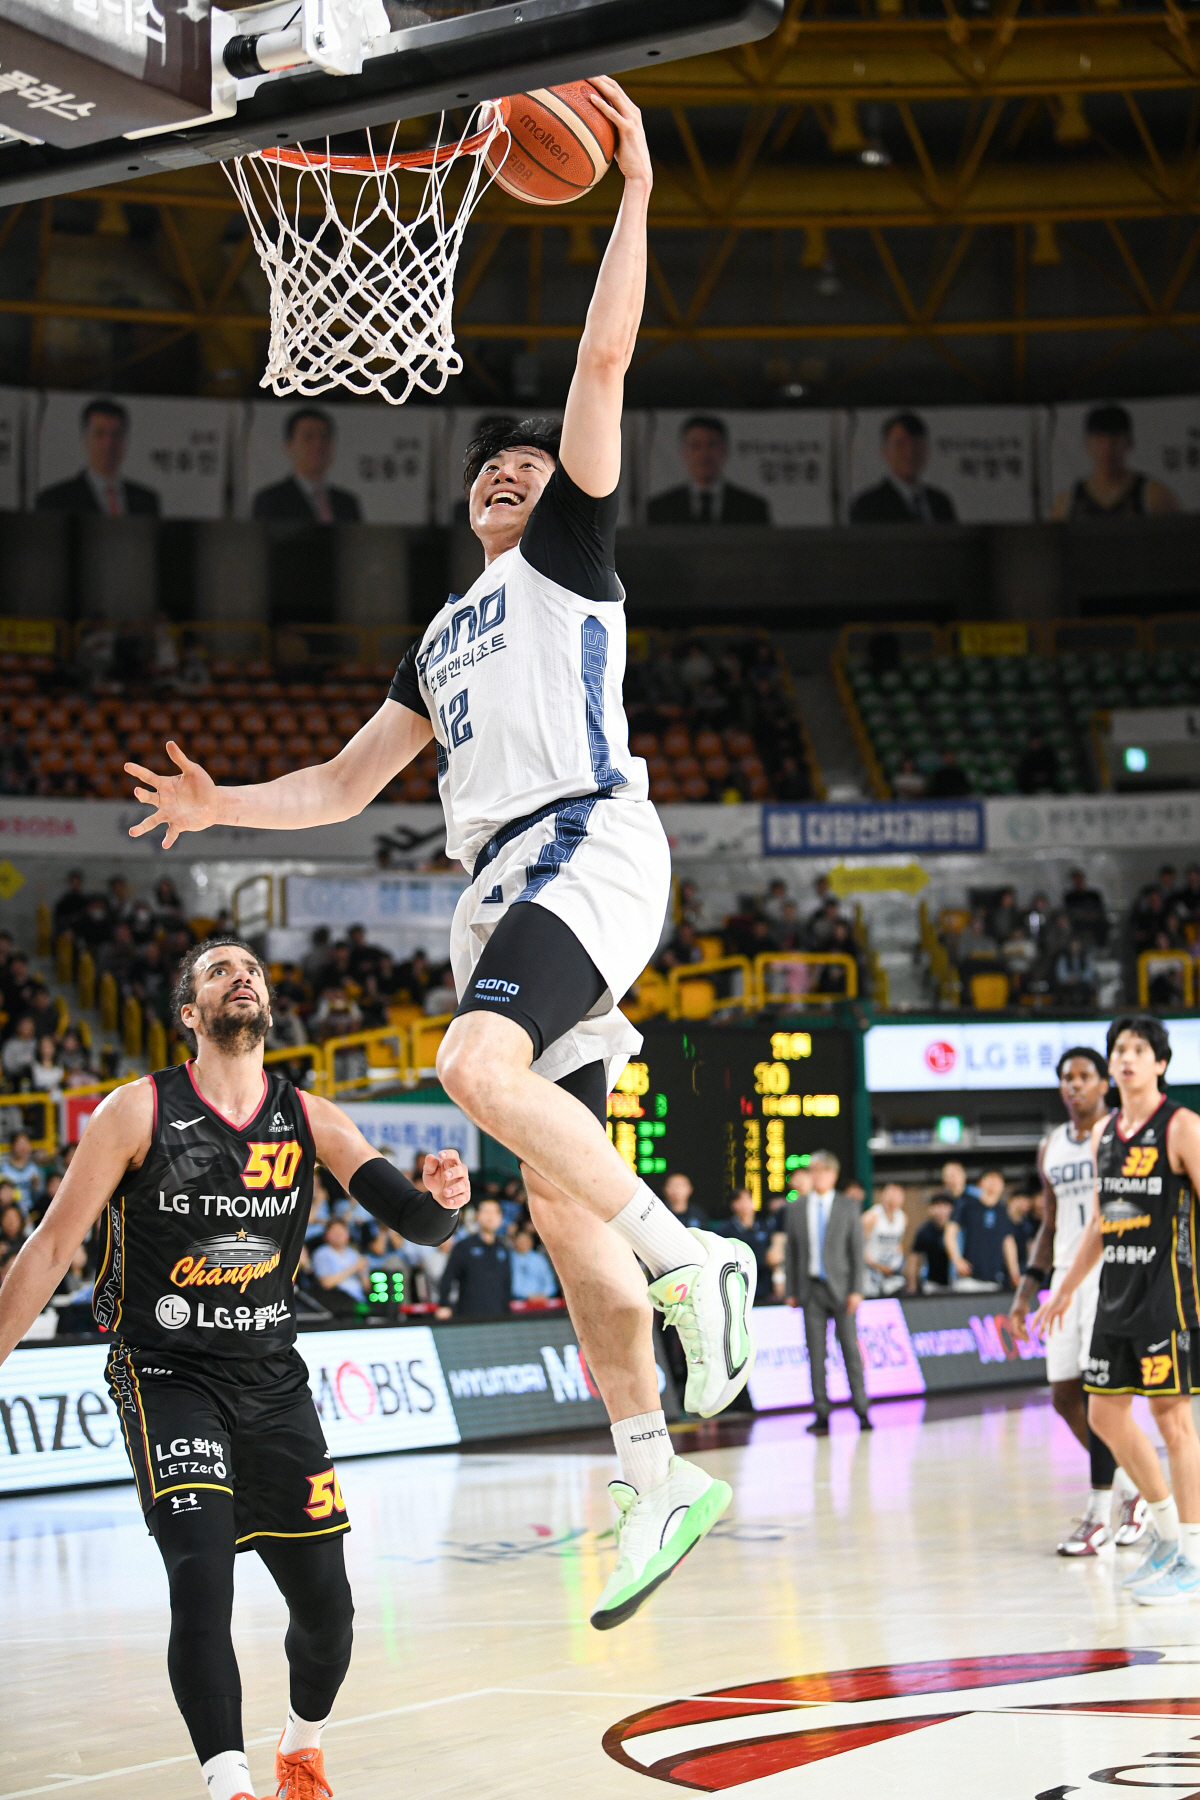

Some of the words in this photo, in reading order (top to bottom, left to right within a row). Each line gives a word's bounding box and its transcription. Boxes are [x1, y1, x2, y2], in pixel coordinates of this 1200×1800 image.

[520, 115, 569, 165] molten
[508, 152, 533, 180] FIBA
[439, 688, 473, 754] 12
[240, 1140, 303, 1190] 50
[1121, 1146, 1159, 1177] 33
[158, 1191, 190, 1215] LG
